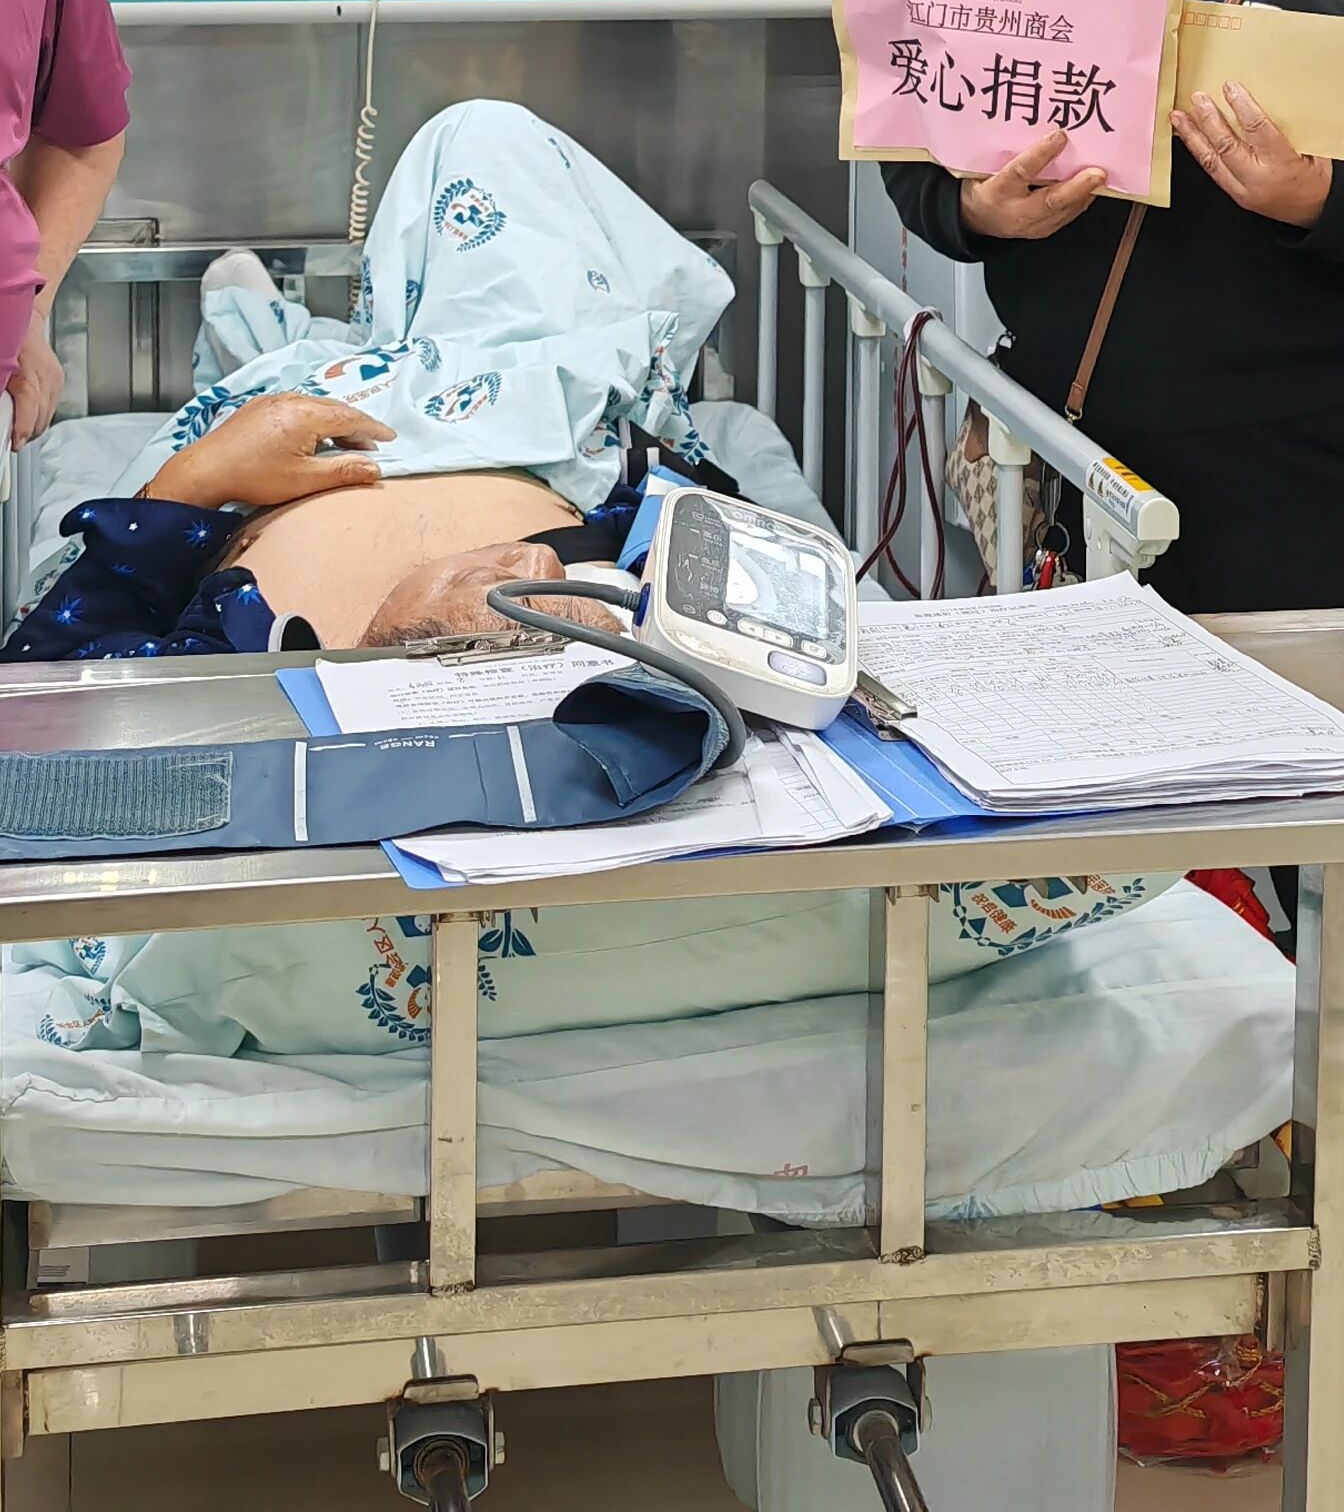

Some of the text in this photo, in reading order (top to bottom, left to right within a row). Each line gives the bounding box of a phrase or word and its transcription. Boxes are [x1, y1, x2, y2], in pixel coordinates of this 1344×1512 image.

[906, 0, 1075, 42] 江门市贵州商会
[888, 38, 1117, 133] 爱心捐款
[380, 739, 436, 750] RANGE
